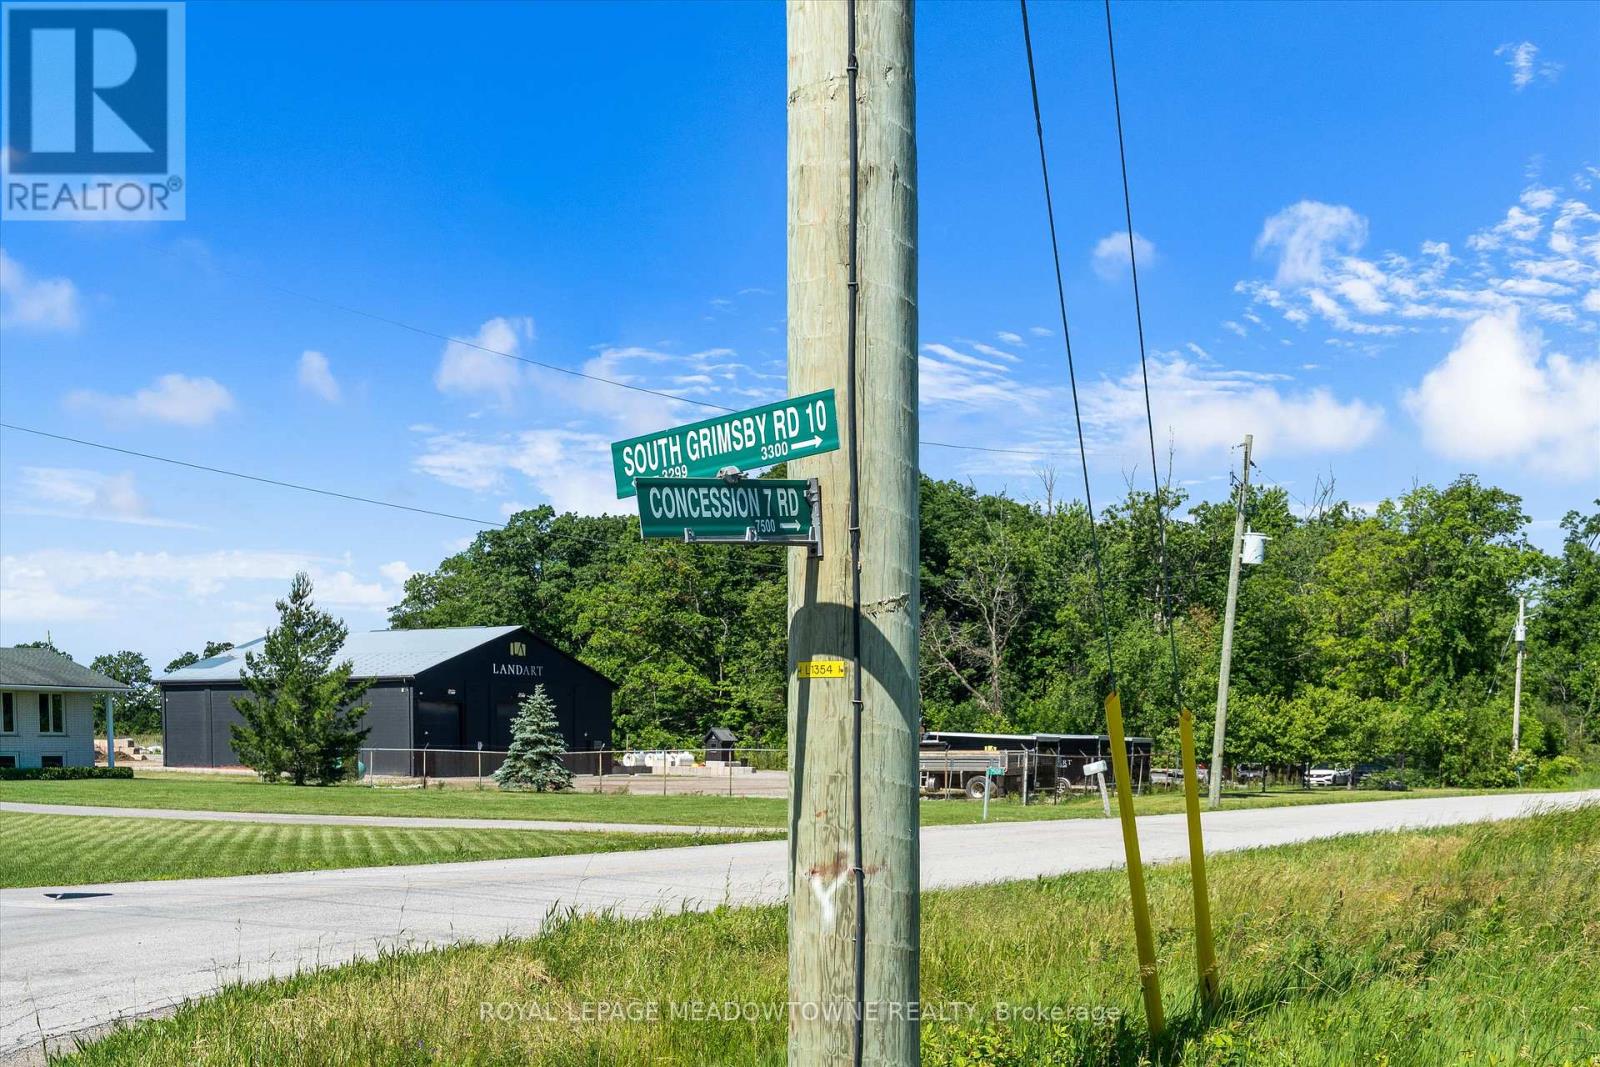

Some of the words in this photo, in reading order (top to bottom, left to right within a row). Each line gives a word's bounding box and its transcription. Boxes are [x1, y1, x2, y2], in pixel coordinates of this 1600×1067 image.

[623, 434, 683, 477] SOUTH
[686, 409, 768, 462] GRIMSBY
[773, 406, 800, 441] RD
[805, 399, 827, 433] 10
[760, 442, 788, 461] 3300
[649, 486, 761, 519] CONCESSION
[763, 488, 773, 517] 7
[777, 487, 799, 518] RD
[755, 519, 776, 533] 7500
[492, 663, 544, 677] LANDART
